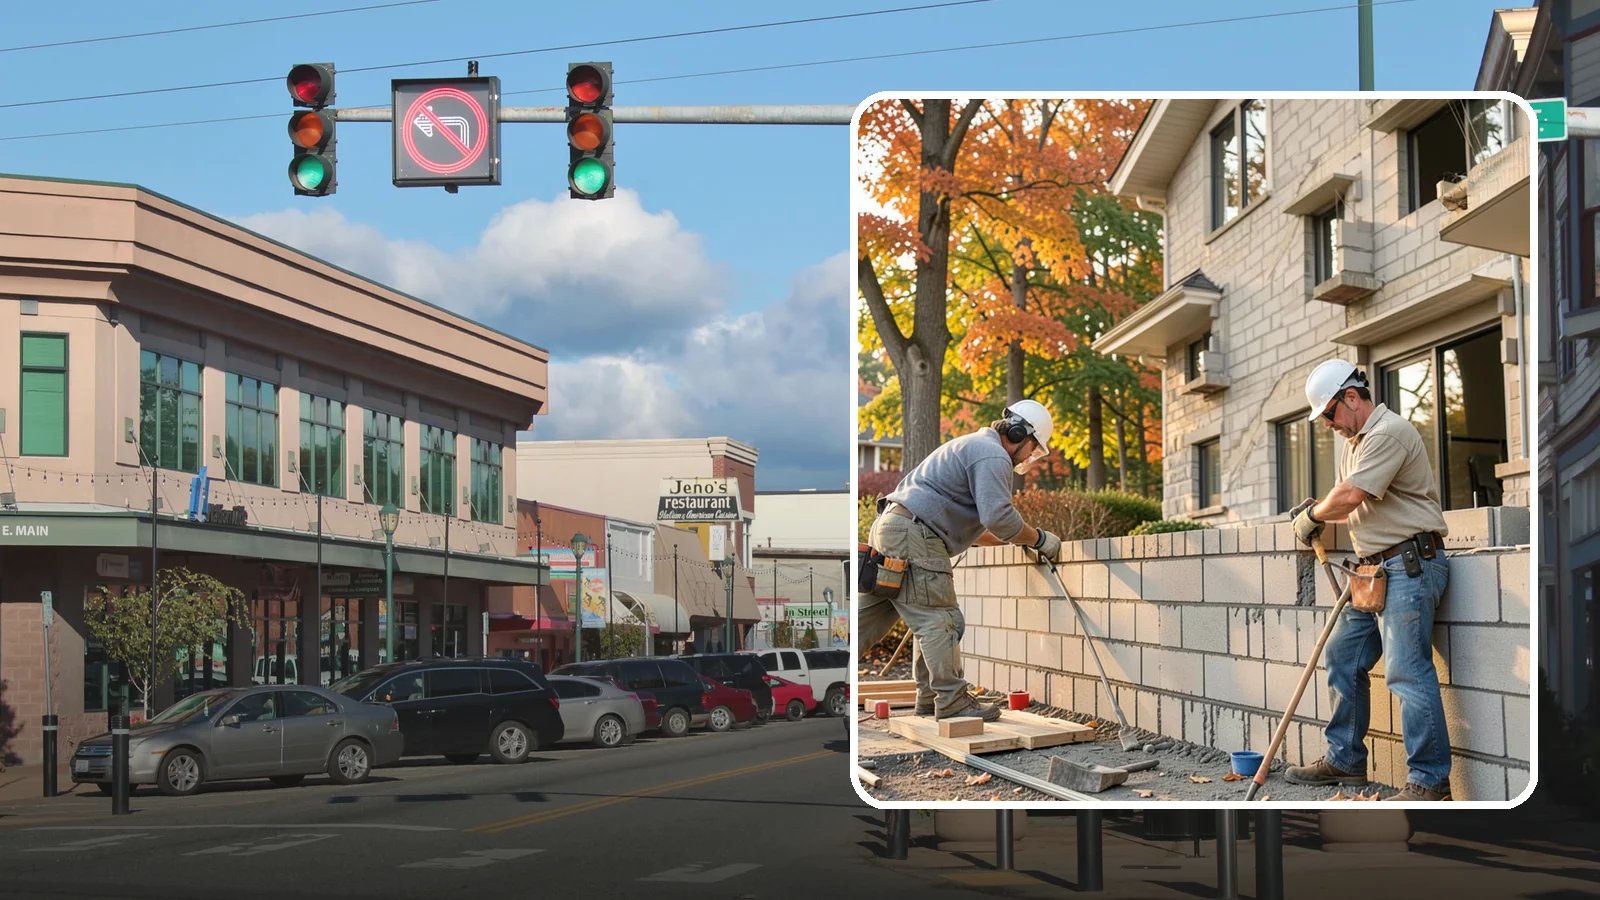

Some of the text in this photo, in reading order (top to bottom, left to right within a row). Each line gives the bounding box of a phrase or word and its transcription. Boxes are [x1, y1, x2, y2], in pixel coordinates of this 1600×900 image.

[670, 480, 728, 494] Jeno's
[665, 496, 731, 509] restaurant
[658, 509, 681, 519] Italian
[686, 509, 714, 519] American
[715, 509, 737, 519] Cuisine
[2, 525, 49, 536] E. MAIN
[786, 607, 794, 617] in
[797, 607, 828, 617] Street
